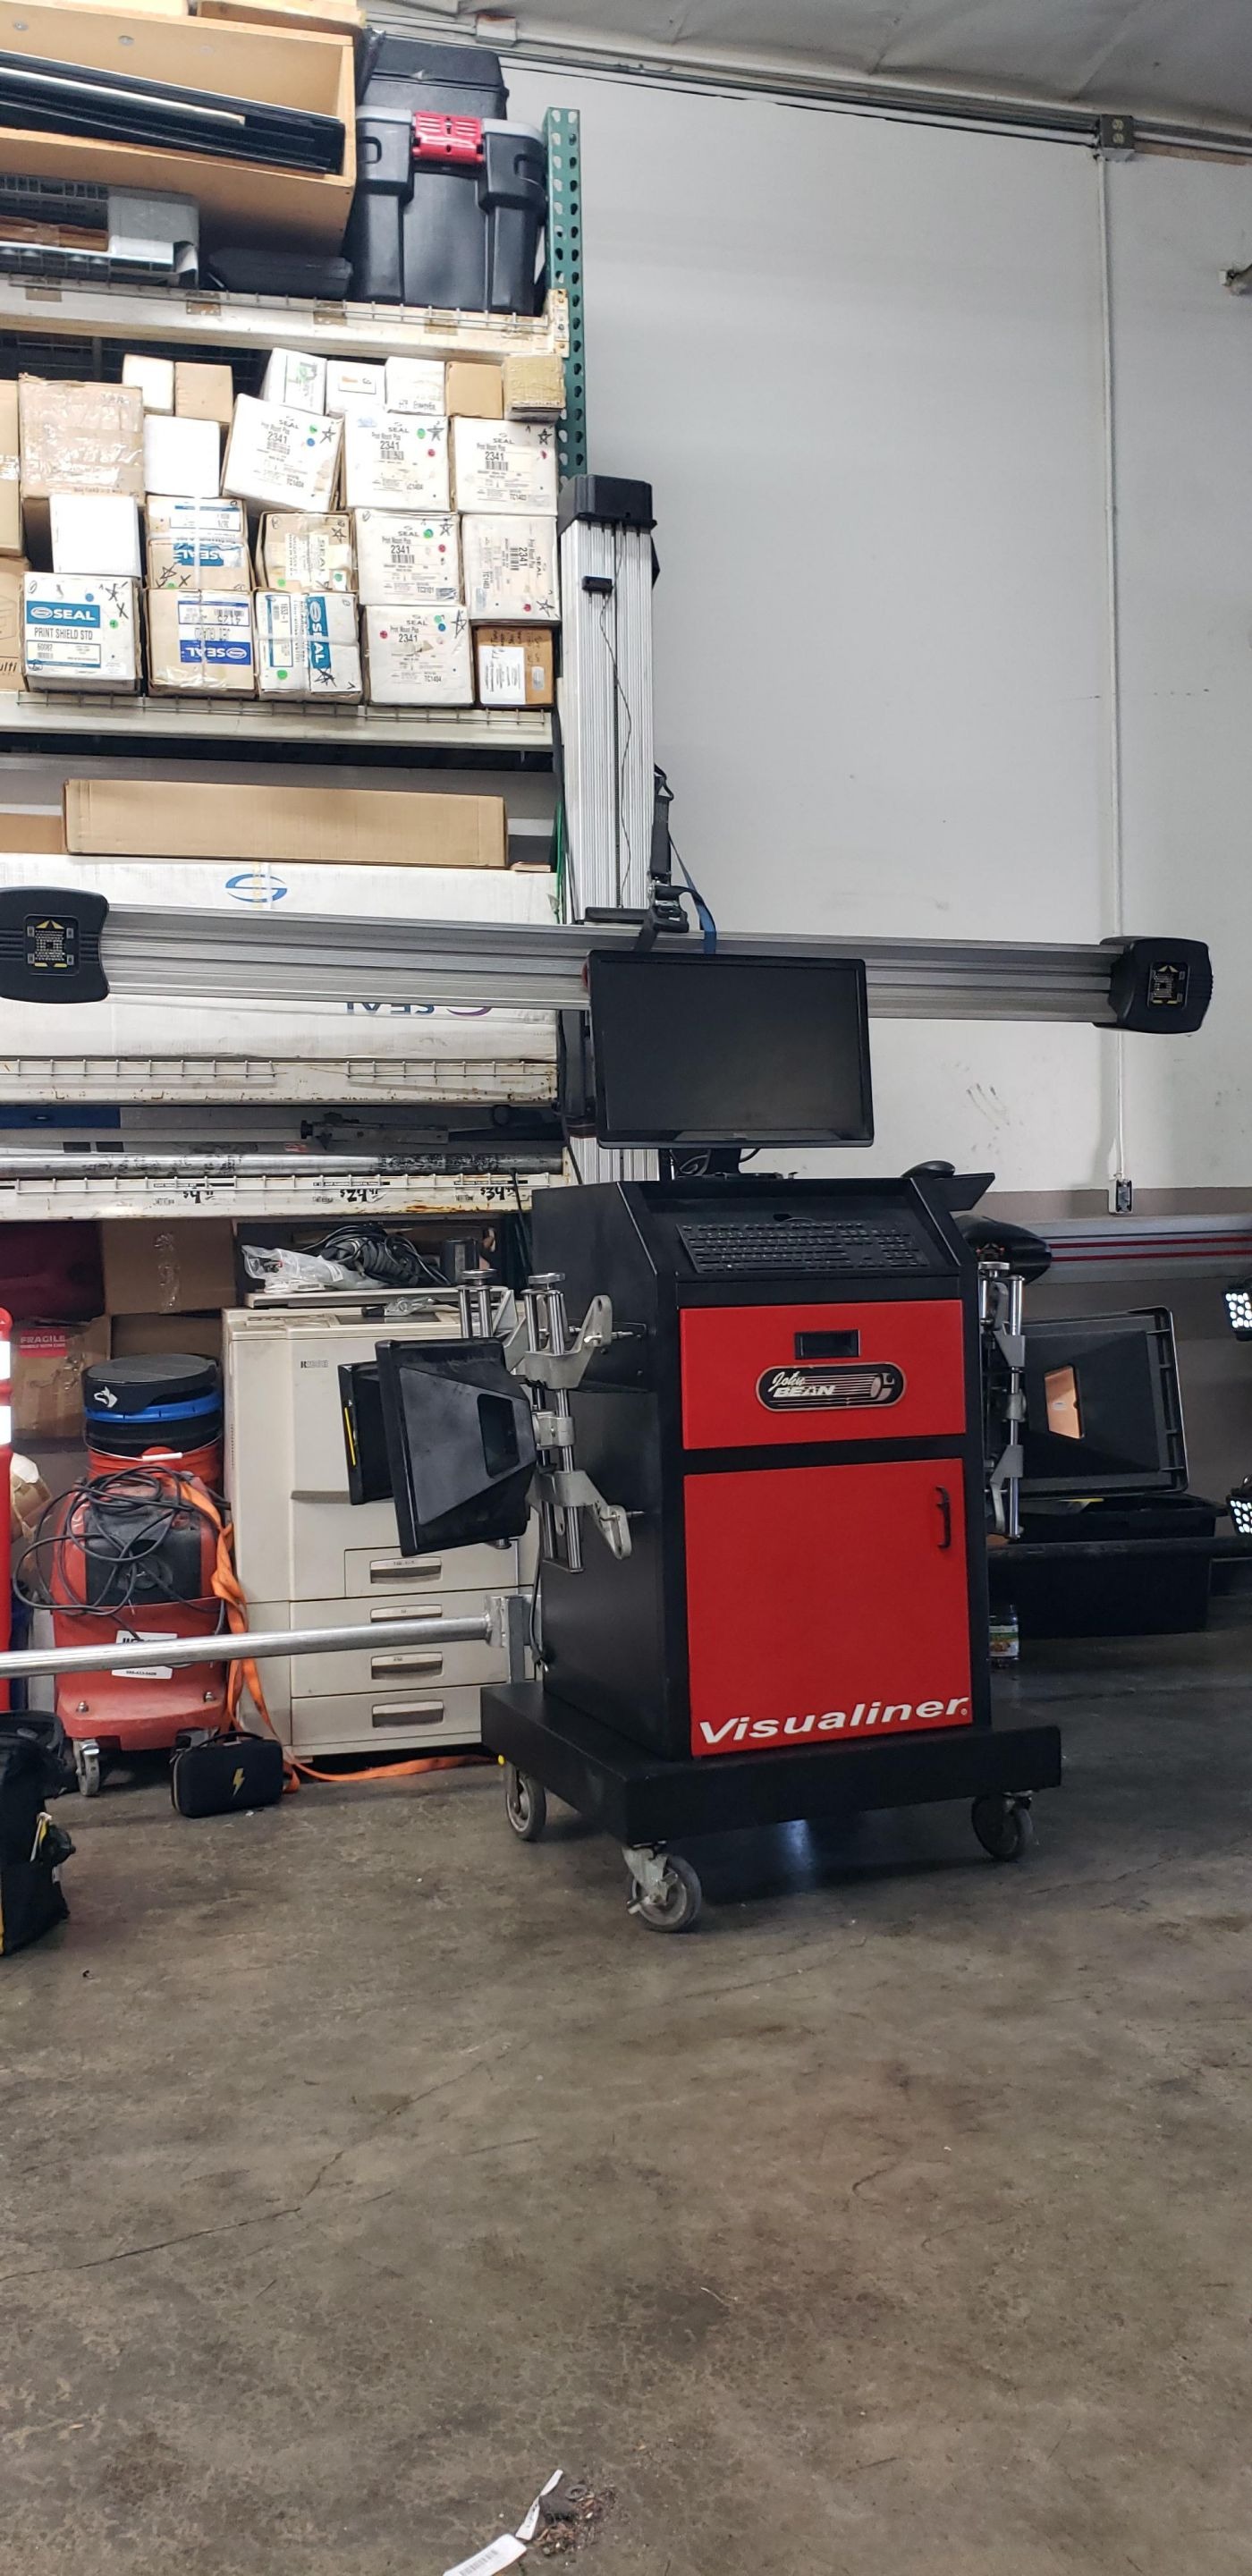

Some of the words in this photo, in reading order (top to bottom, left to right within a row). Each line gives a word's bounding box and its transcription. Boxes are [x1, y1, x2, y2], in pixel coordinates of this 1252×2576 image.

[267, 431, 287, 445] 2341
[380, 440, 400, 450] 2341
[485, 451, 504, 461] 2341
[391, 545, 410, 555] 2341
[519, 547, 529, 567] 2341
[54, 609, 97, 621] SEAL
[34, 627, 54, 638] PRINT
[55, 628, 79, 640] SHIELD
[80, 630, 93, 640] STD
[399, 633, 418, 643] 2341
[185, 647, 225, 657] SEAL
[20, 1335, 65, 1343] FRAGILE
[768, 1371, 806, 1392] John
[773, 1385, 836, 1397] BEAN
[699, 1697, 969, 1743] Visualiner
